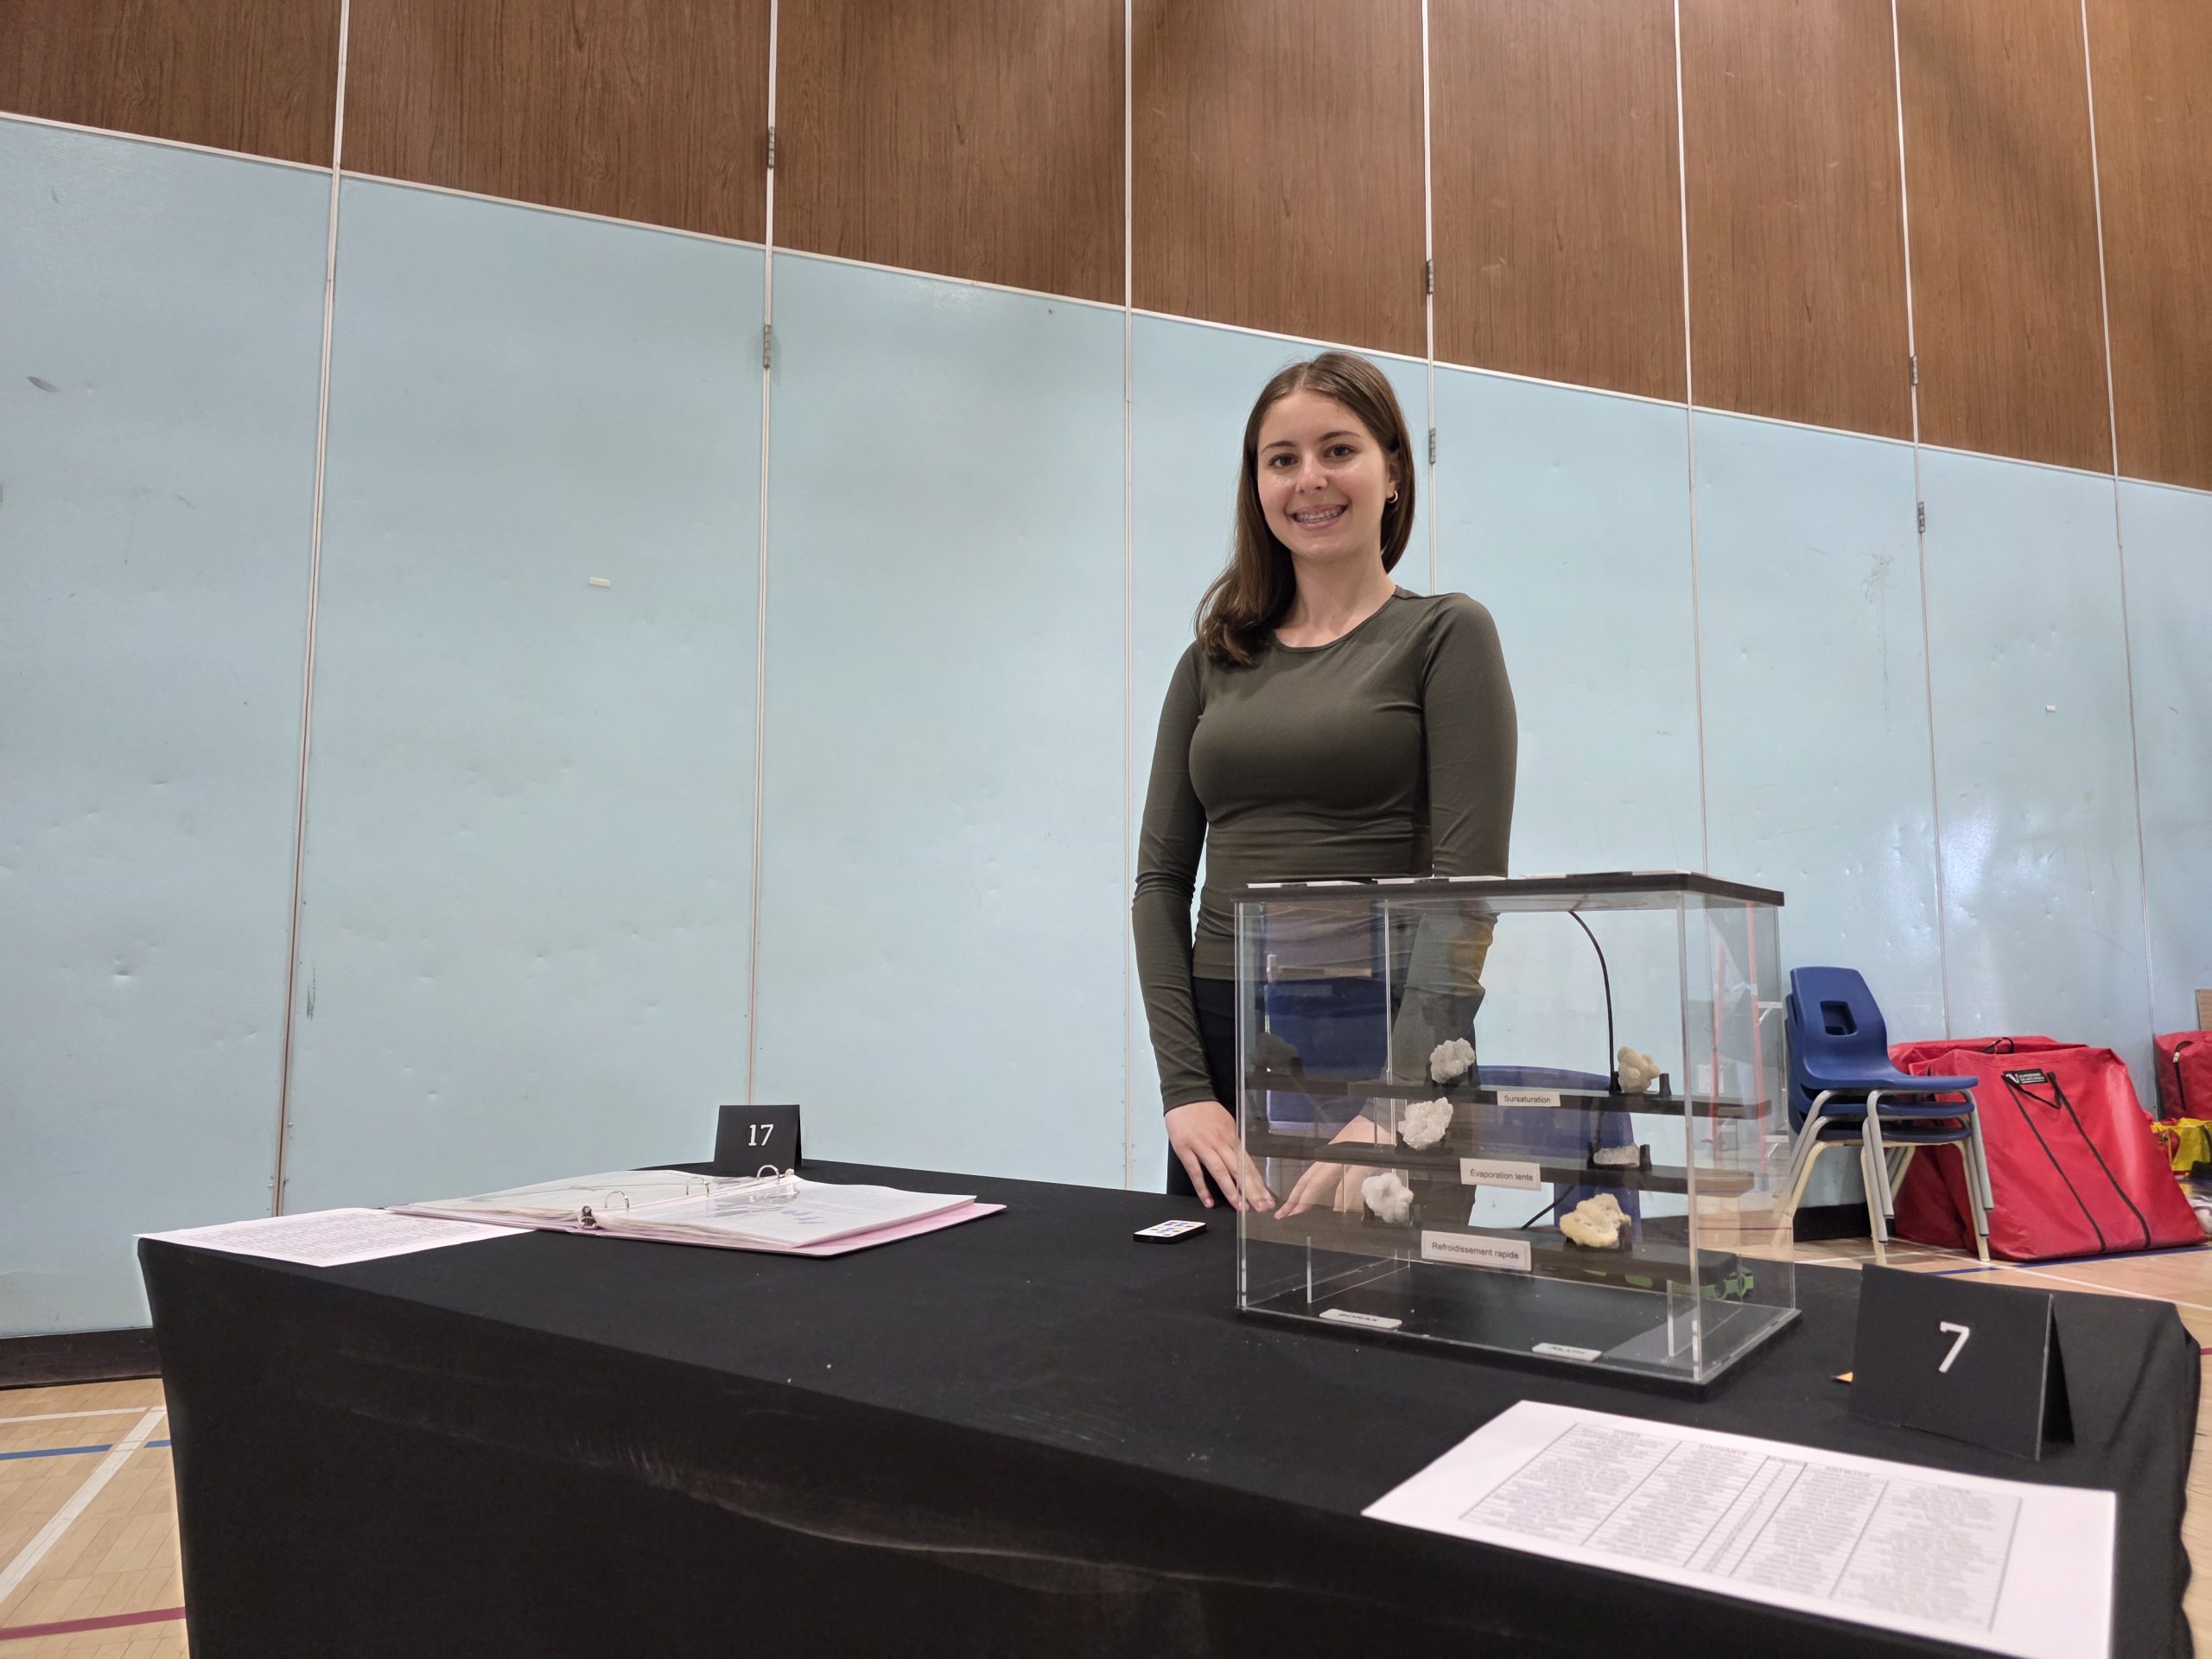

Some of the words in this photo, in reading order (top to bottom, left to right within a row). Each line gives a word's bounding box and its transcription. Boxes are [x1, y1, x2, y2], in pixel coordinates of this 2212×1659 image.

[1503, 1094, 1551, 1103] Sursaturation
[747, 1123, 774, 1147] 17
[1470, 1167, 1514, 1180] Évaporation
[1515, 1173, 1534, 1181] lente
[1431, 1242, 1493, 1256] Refroidissement
[1494, 1250, 1519, 1260] rapide
[1938, 1320, 1970, 1373] 7
